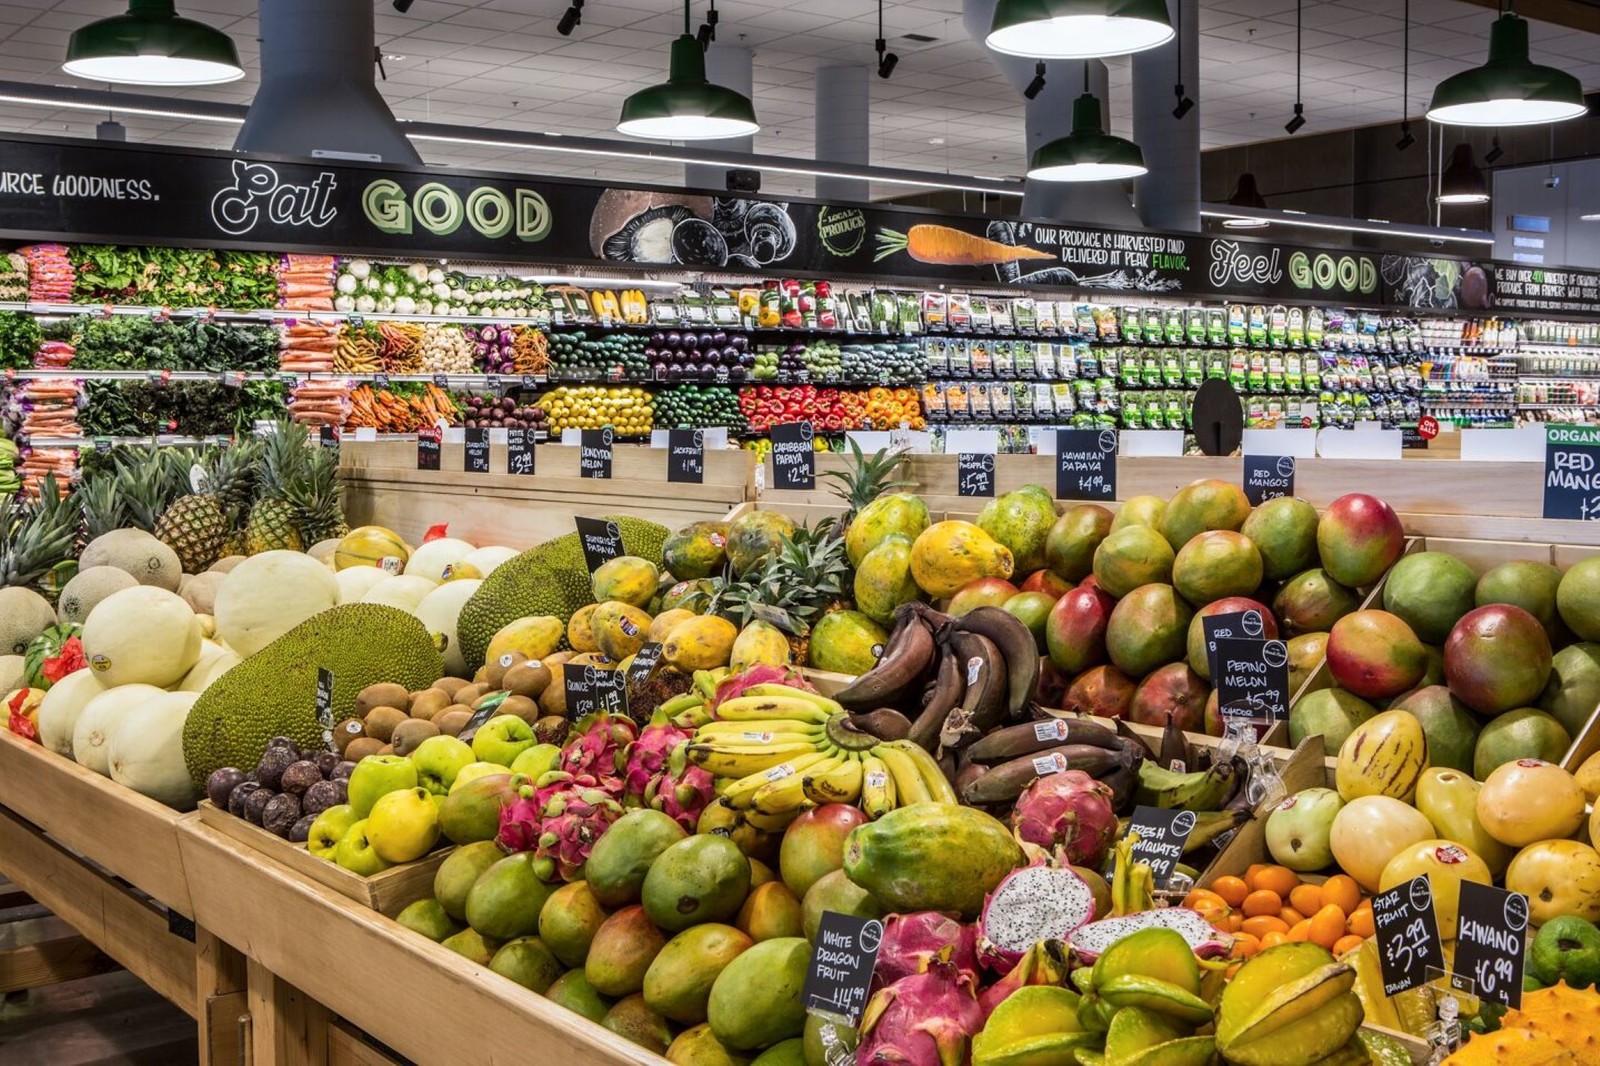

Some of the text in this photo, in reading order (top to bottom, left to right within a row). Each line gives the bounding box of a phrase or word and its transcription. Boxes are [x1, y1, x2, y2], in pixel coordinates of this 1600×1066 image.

[52, 175, 160, 201] GOODNESS.
[211, 159, 338, 235] Eat
[361, 178, 553, 242] GOOD
[1034, 228, 1185, 254] OUR PRODUCE IS HARVESTED AND
[1062, 246, 1190, 271] DELIVERED AT PEAK FLAVOR.
[1209, 239, 1283, 288] Feel
[1288, 251, 1377, 294] GOOD
[1420, 424, 1437, 435] SALE
[1424, 420, 1435, 428] ON
[773, 440, 813, 453] CARIBBEAN
[1062, 451, 1106, 460] HAWAIIAN
[775, 453, 803, 465] PAPAYA
[1062, 461, 1102, 471] PAPAYA
[1553, 451, 1595, 472] RED
[1249, 478, 1289, 487] MANGOS
[1253, 469, 1270, 478] RED
[585, 534, 616, 547] SUNRISE
[587, 543, 617, 556] PAPAYA
[1213, 628, 1232, 638] RED
[1227, 660, 1267, 673] PEPINO
[1225, 675, 1267, 687] MELON
[1373, 891, 1400, 912] STAR
[1376, 903, 1409, 928] FRUIT
[823, 930, 852, 948] WHITE
[1459, 916, 1519, 956] KIWANO
[816, 947, 860, 970] DRAGON
[816, 964, 850, 982] FRUIT
